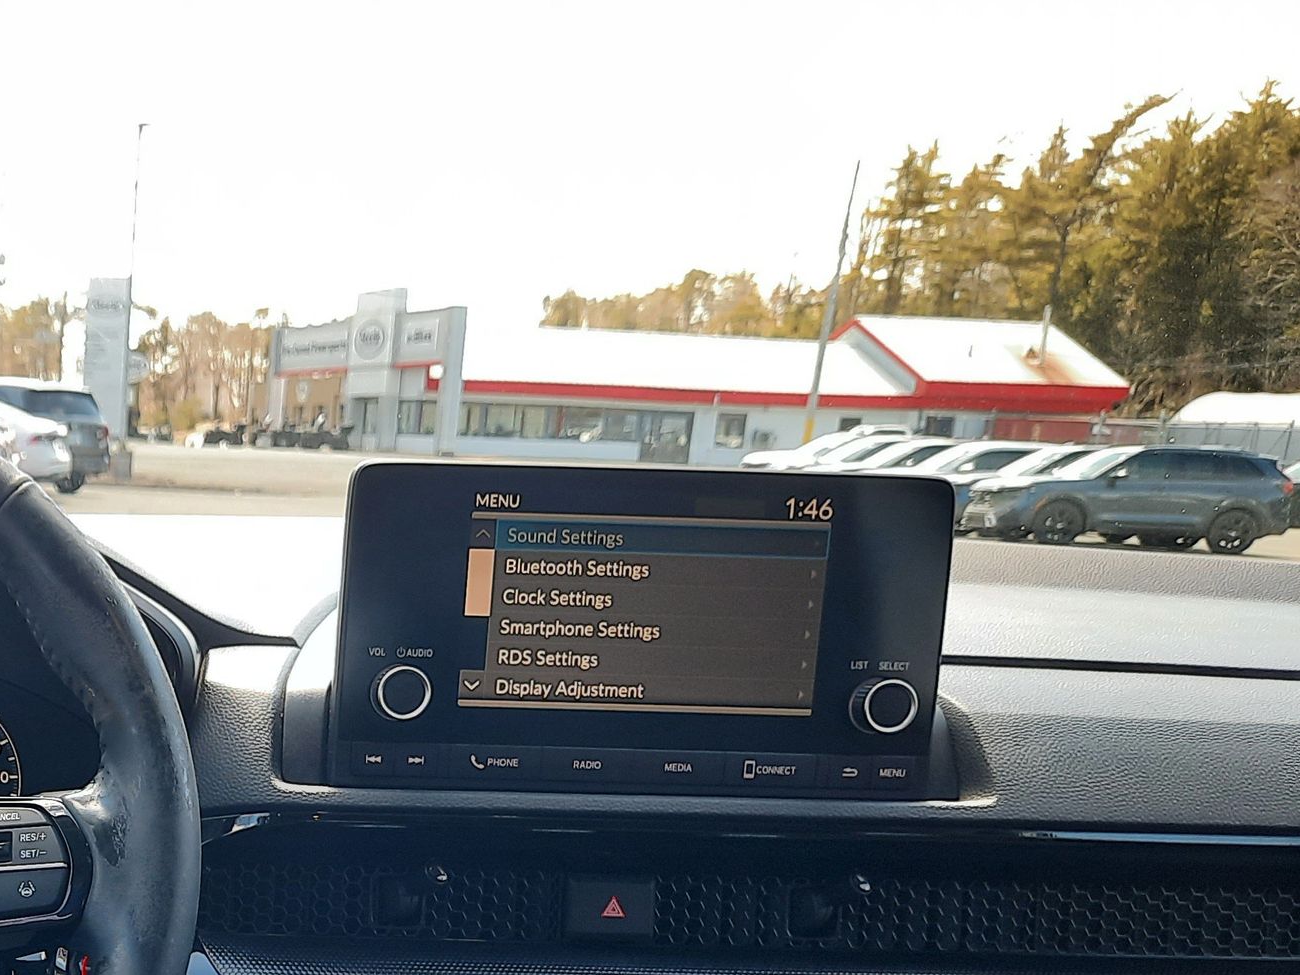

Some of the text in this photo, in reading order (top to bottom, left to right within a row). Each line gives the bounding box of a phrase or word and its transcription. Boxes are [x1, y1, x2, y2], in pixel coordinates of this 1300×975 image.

[475, 493, 521, 508] MENU
[785, 497, 833, 520] 1:46
[507, 527, 624, 548] Sound Settings
[505, 558, 650, 580] Bluetooth Settings
[503, 589, 612, 609] Clock Settings
[500, 619, 660, 641] Smartphone Settings
[368, 647, 386, 657] VOL
[406, 648, 434, 658] AUDIO
[498, 649, 599, 670] RDS Settings
[850, 660, 869, 670] LIST
[878, 661, 910, 671] SELECT
[495, 679, 645, 699] Display Adjustment
[487, 757, 519, 768] PHONE
[573, 760, 601, 770] RADIO
[664, 762, 693, 773] MEDIA
[756, 765, 797, 776] CONNECT
[879, 768, 906, 778] MENU
